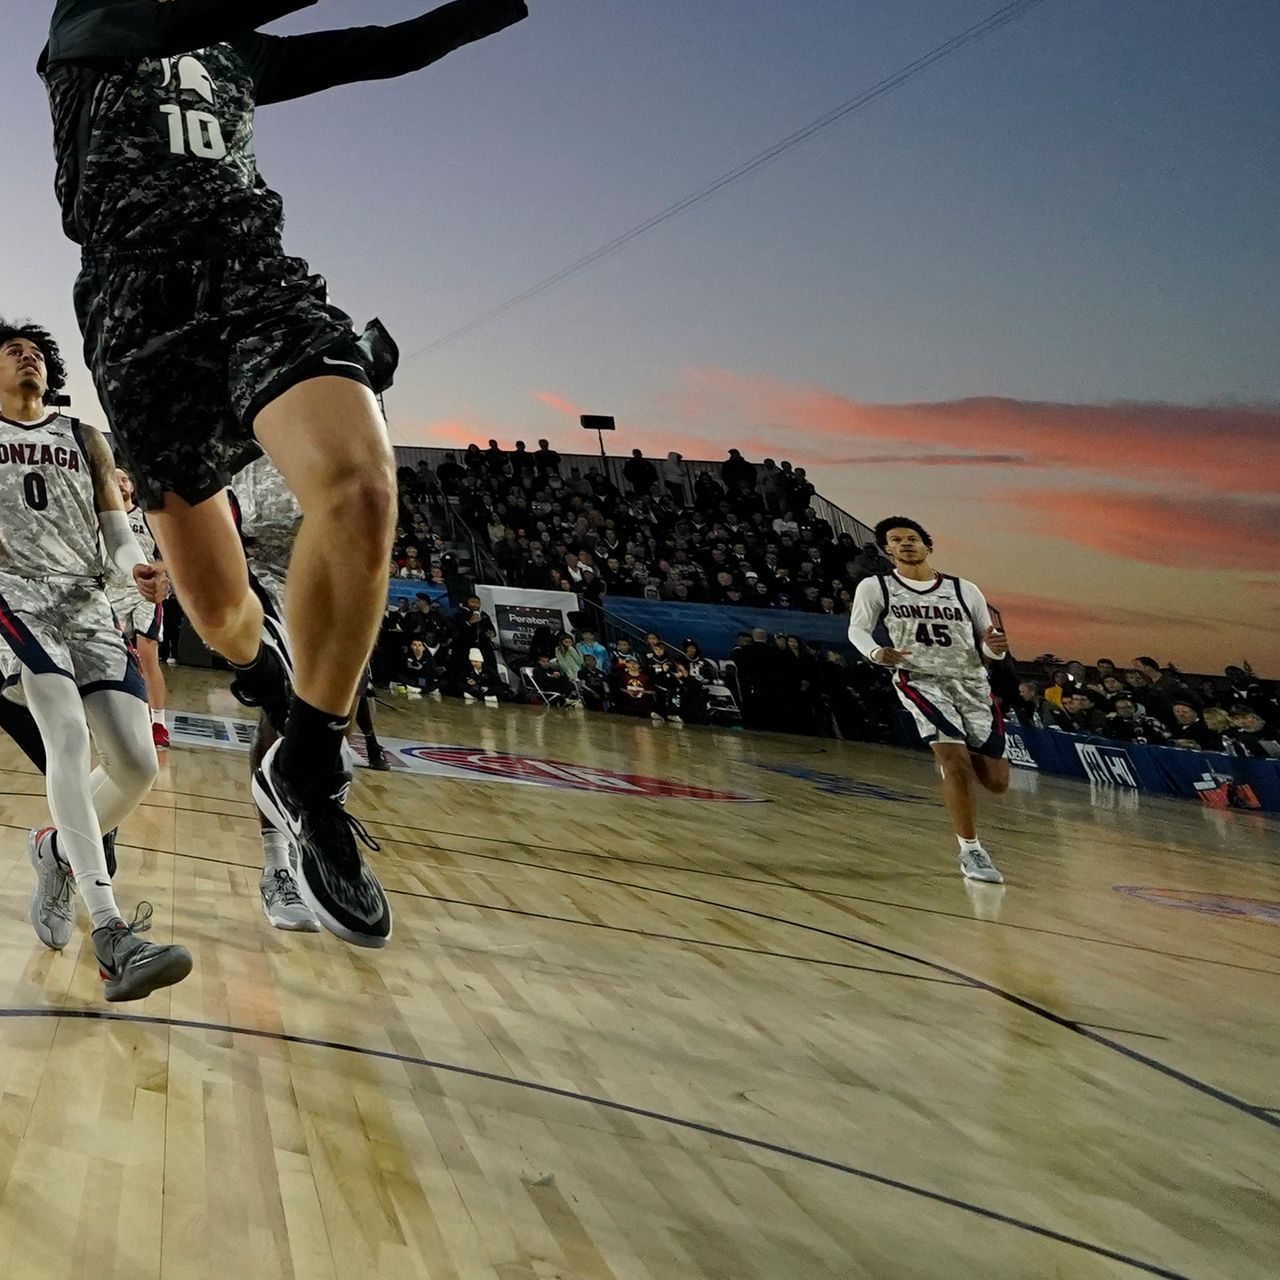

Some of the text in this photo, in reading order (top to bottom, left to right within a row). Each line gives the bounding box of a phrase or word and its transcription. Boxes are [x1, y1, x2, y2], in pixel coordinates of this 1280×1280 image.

[159, 103, 228, 160] 10
[23, 472, 48, 510] 0
[891, 605, 963, 622] GONZAGA
[915, 623, 952, 647] 45
